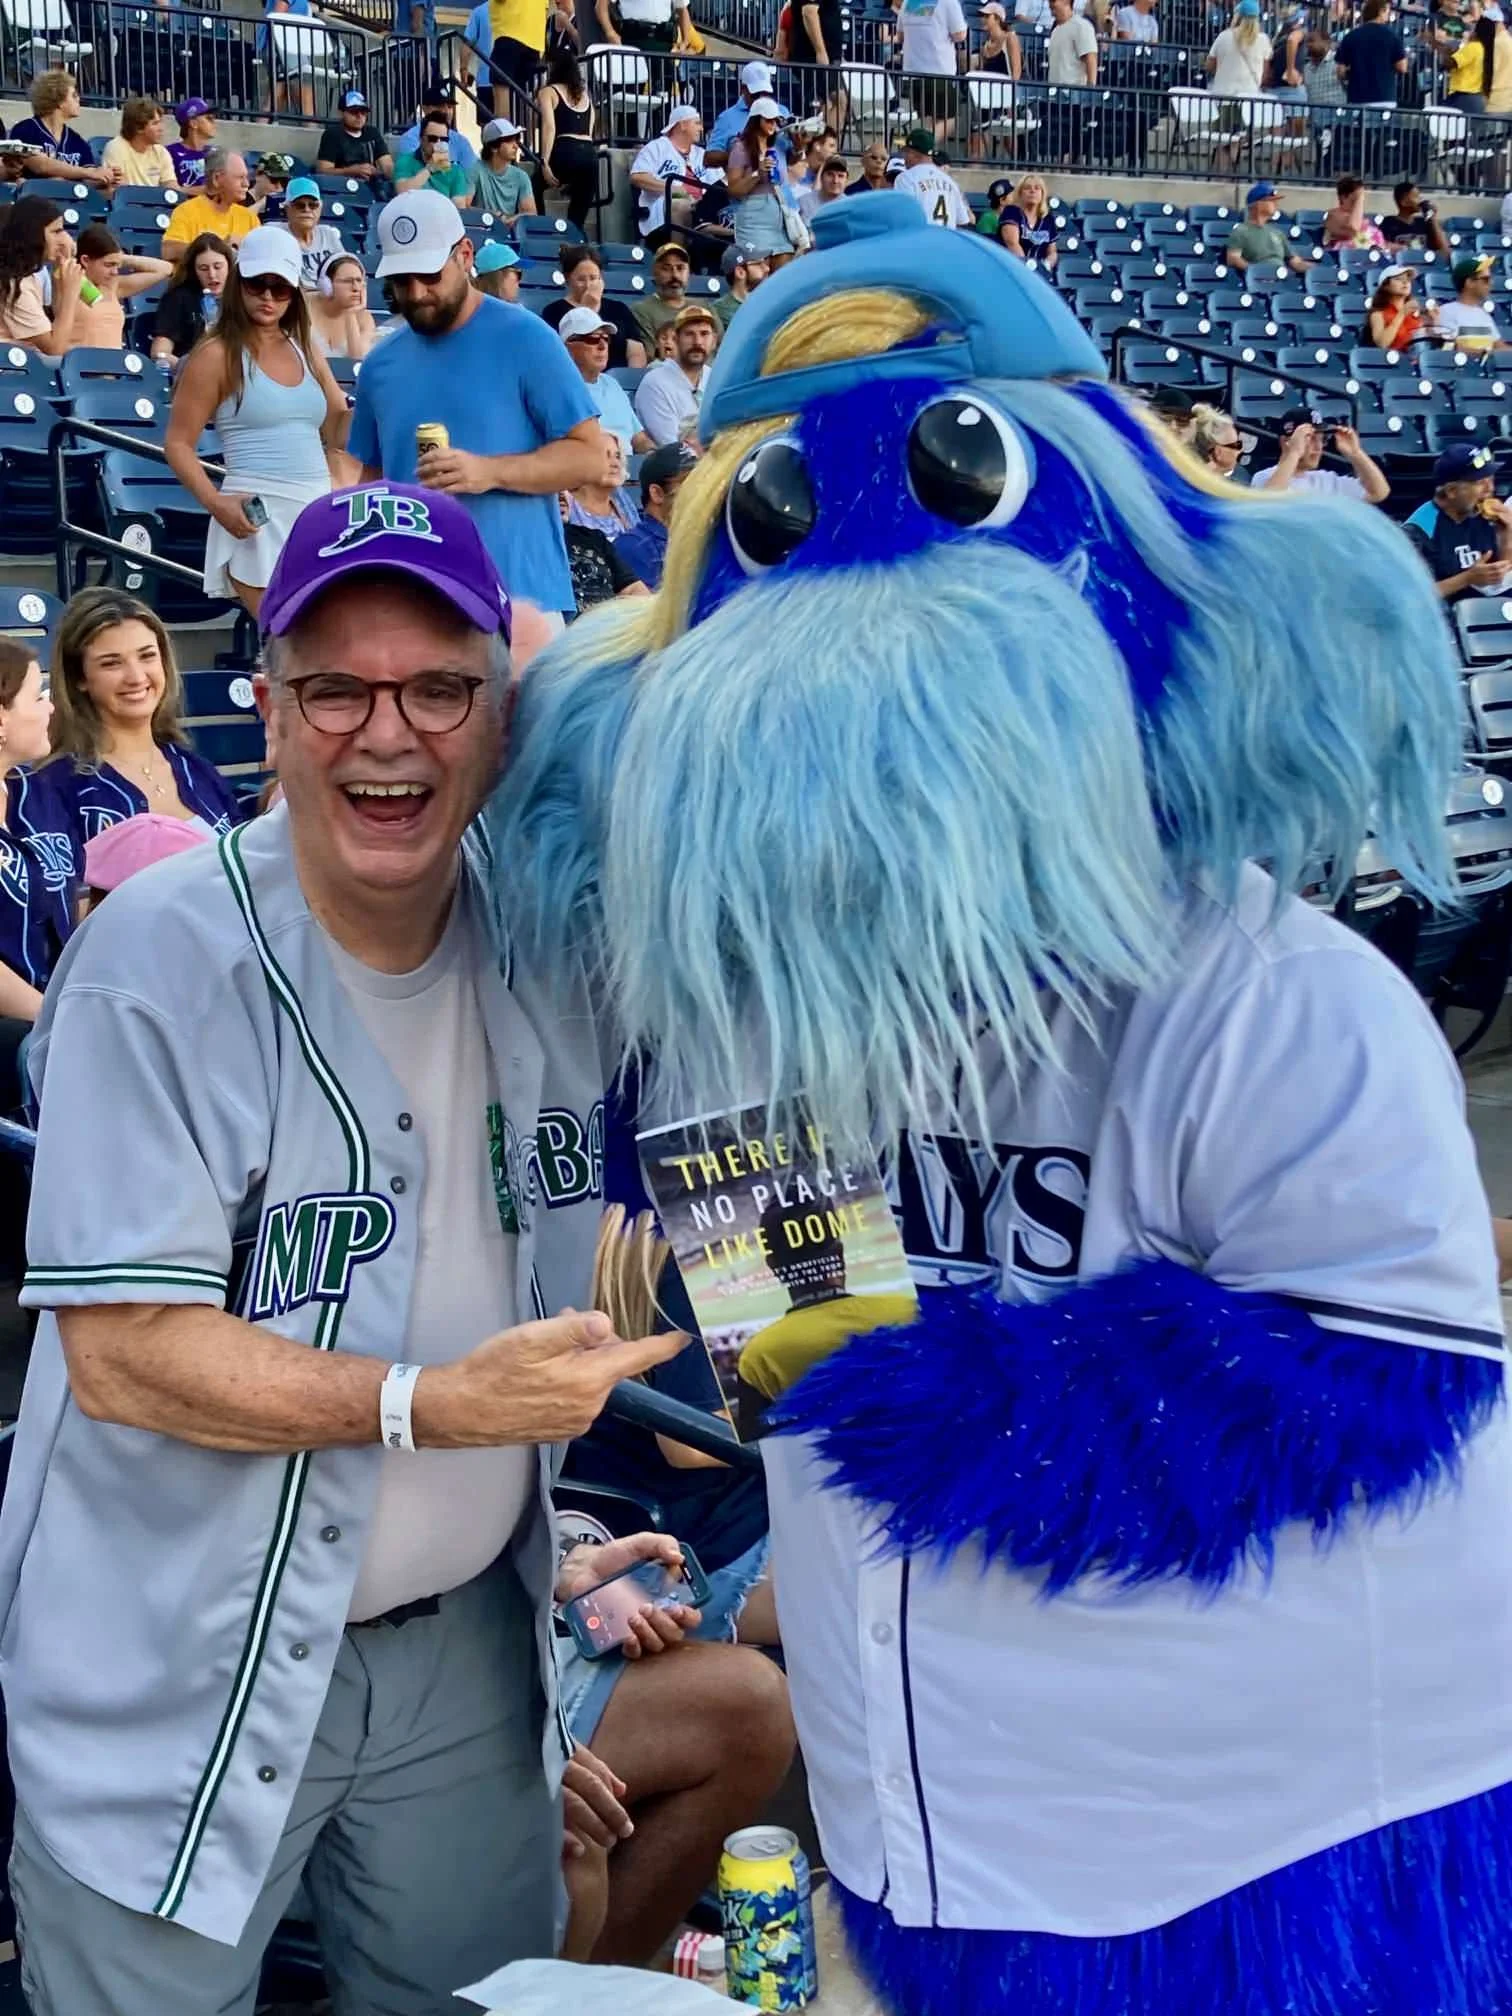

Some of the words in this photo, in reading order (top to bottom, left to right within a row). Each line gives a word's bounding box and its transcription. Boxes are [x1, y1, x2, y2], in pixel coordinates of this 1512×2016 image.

[933, 194, 949, 226] 4
[332, 487, 433, 537] TB
[674, 1133, 792, 1190] THERE
[690, 1194, 736, 1231] NO
[752, 1165, 859, 1214] PLACE
[886, 1128, 1096, 1302] AYS
[704, 1227, 773, 1269] LIKE
[783, 1203, 870, 1249] DOME
